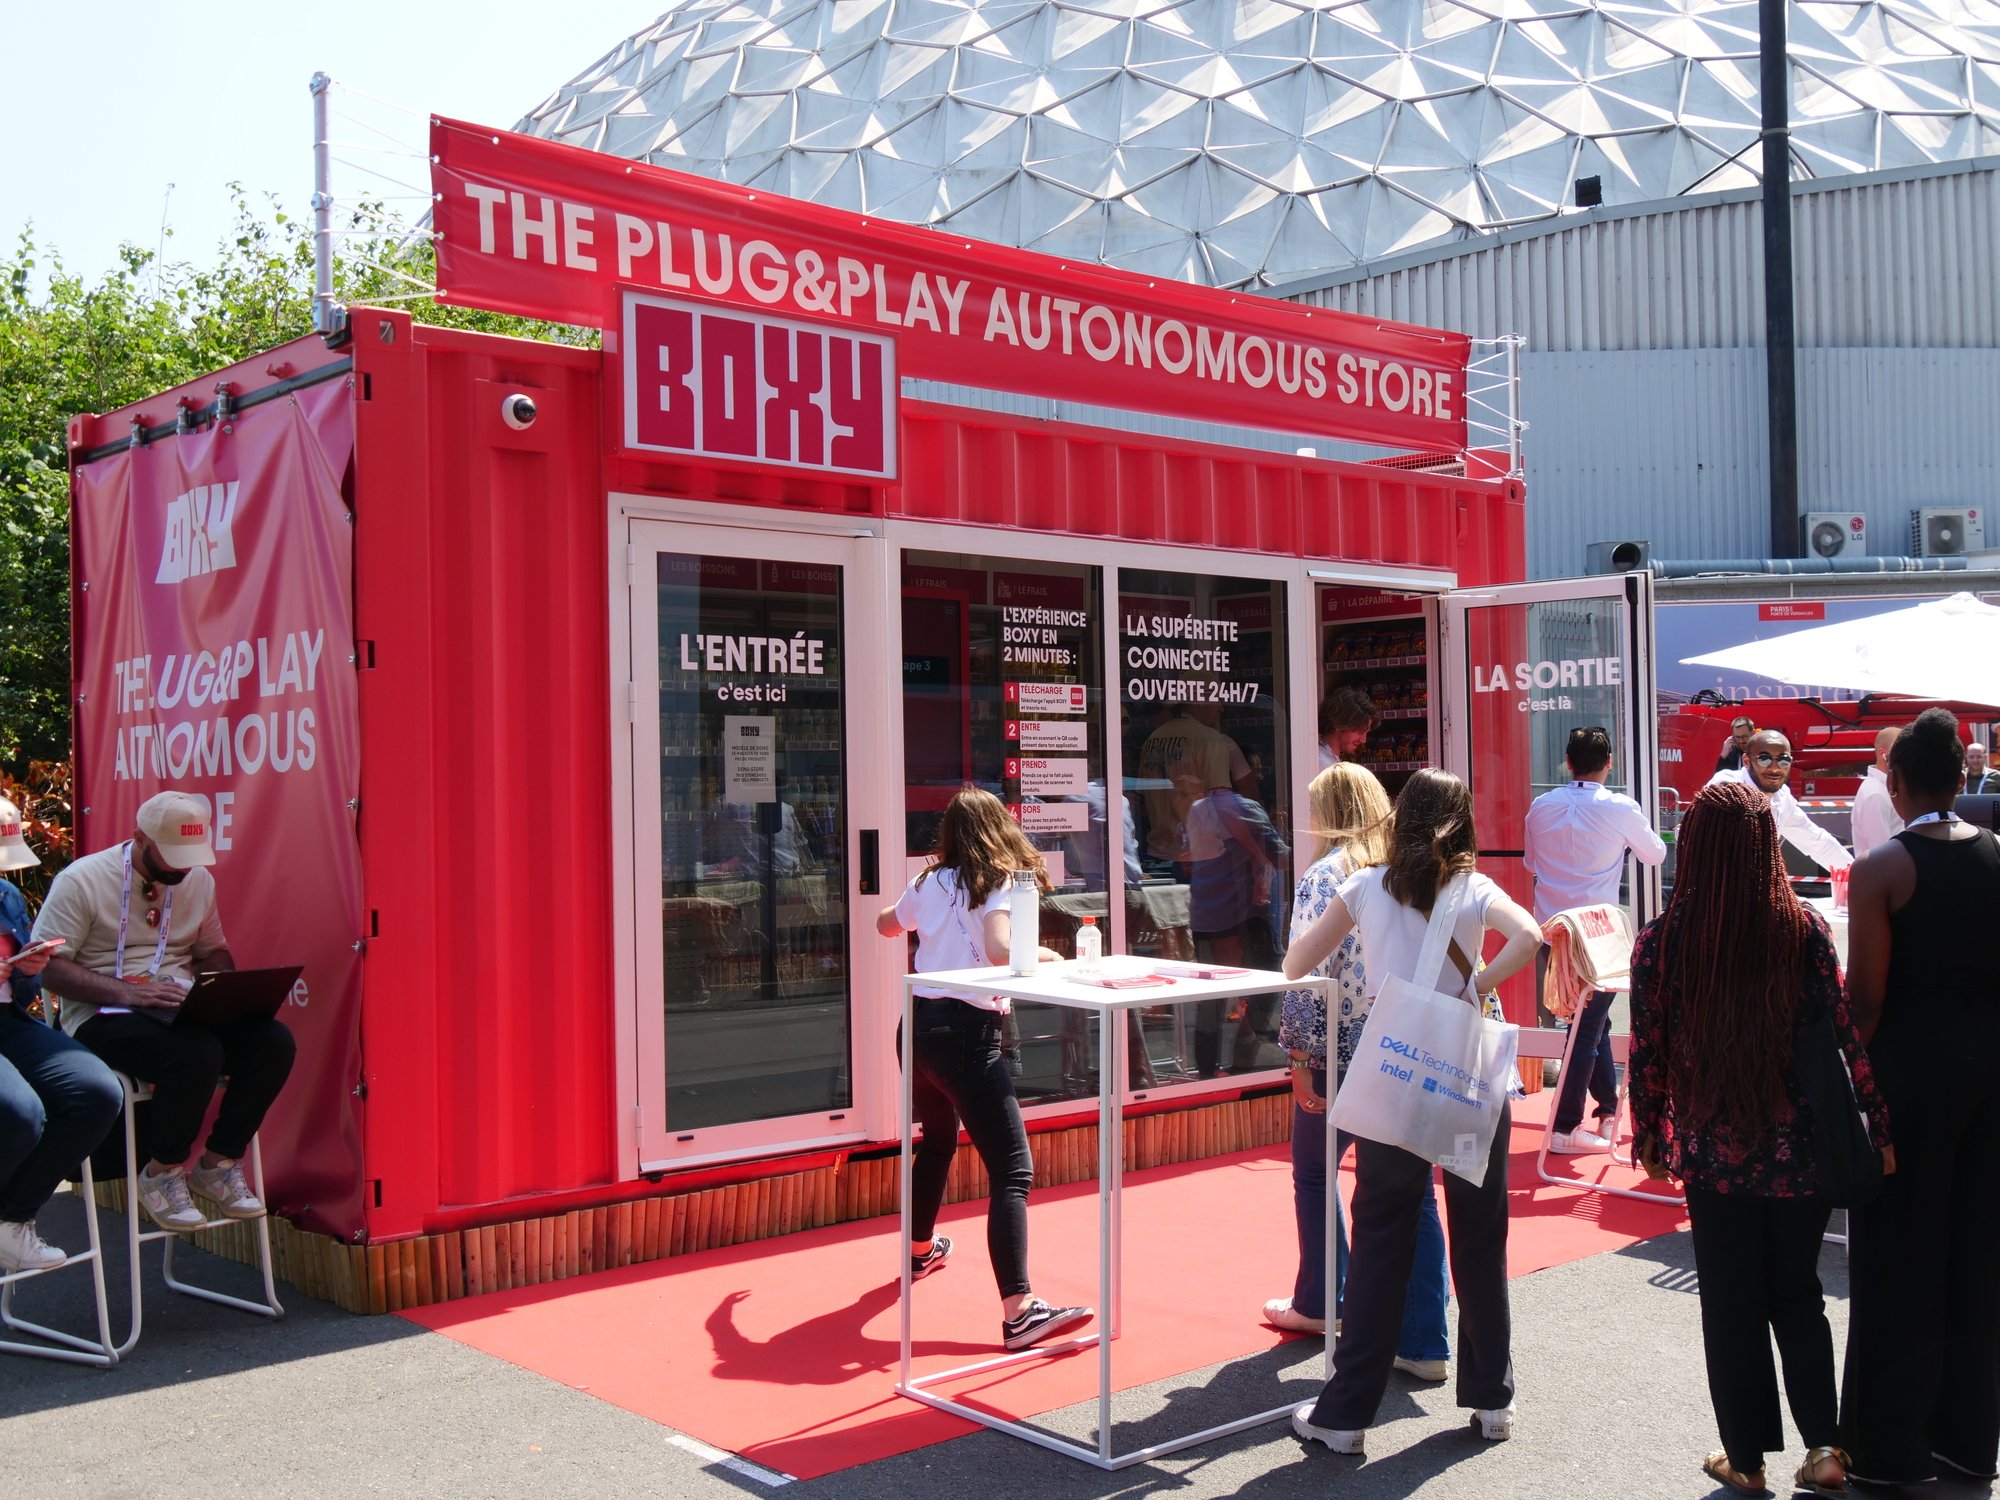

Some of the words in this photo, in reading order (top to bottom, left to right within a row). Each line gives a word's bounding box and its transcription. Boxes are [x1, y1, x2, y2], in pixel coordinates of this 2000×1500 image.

[464, 183, 598, 272] THE
[615, 213, 971, 336] PLUG&PLAY
[983, 287, 1328, 399] AUTONOMOUS
[1337, 352, 1453, 420] STORE
[633, 302, 885, 474] BOXY
[155, 480, 240, 584] BOXY
[1851, 533, 1863, 541] LG
[671, 561, 687, 572] LES
[791, 569, 806, 580] LES
[1003, 605, 1087, 628] L'EXPÉRIENCE
[1003, 626, 1040, 644] BOXY
[1042, 628, 1058, 645] EN
[1126, 614, 1148, 637] LA
[1151, 613, 1239, 642] SUPÉRETTE
[680, 630, 824, 675] L'ENTRÉE
[1003, 646, 1012, 662] 2
[1014, 646, 1071, 665] MINUTES
[1127, 646, 1230, 672] CONNECTÉE
[903, 662, 922, 673] ape
[924, 660, 931, 671] 3
[1474, 664, 1510, 693] LA
[1515, 656, 1621, 691] SORTIE
[717, 682, 762, 701] c'est
[765, 683, 786, 702] ici
[1009, 685, 1015, 699] 1
[1020, 684, 1063, 695] TÉLÉCHARGE
[1128, 678, 1205, 702] OUVERTE
[1208, 680, 1259, 703] 24H/7
[1517, 697, 1556, 712] c'est
[1558, 695, 1572, 710] là
[1008, 723, 1016, 737] 2
[1021, 723, 1041, 731] ENTRE
[1659, 748, 1683, 763] OXAM
[1009, 760, 1017, 774] 3
[1021, 760, 1047, 769] PRENDS
[1022, 805, 1041, 814] SORS
[181, 824, 203, 836] BOXY
[1379, 1035, 1419, 1062] DELL
[1380, 1059, 1414, 1083] intel
[1439, 1085, 1475, 1107] Windows
